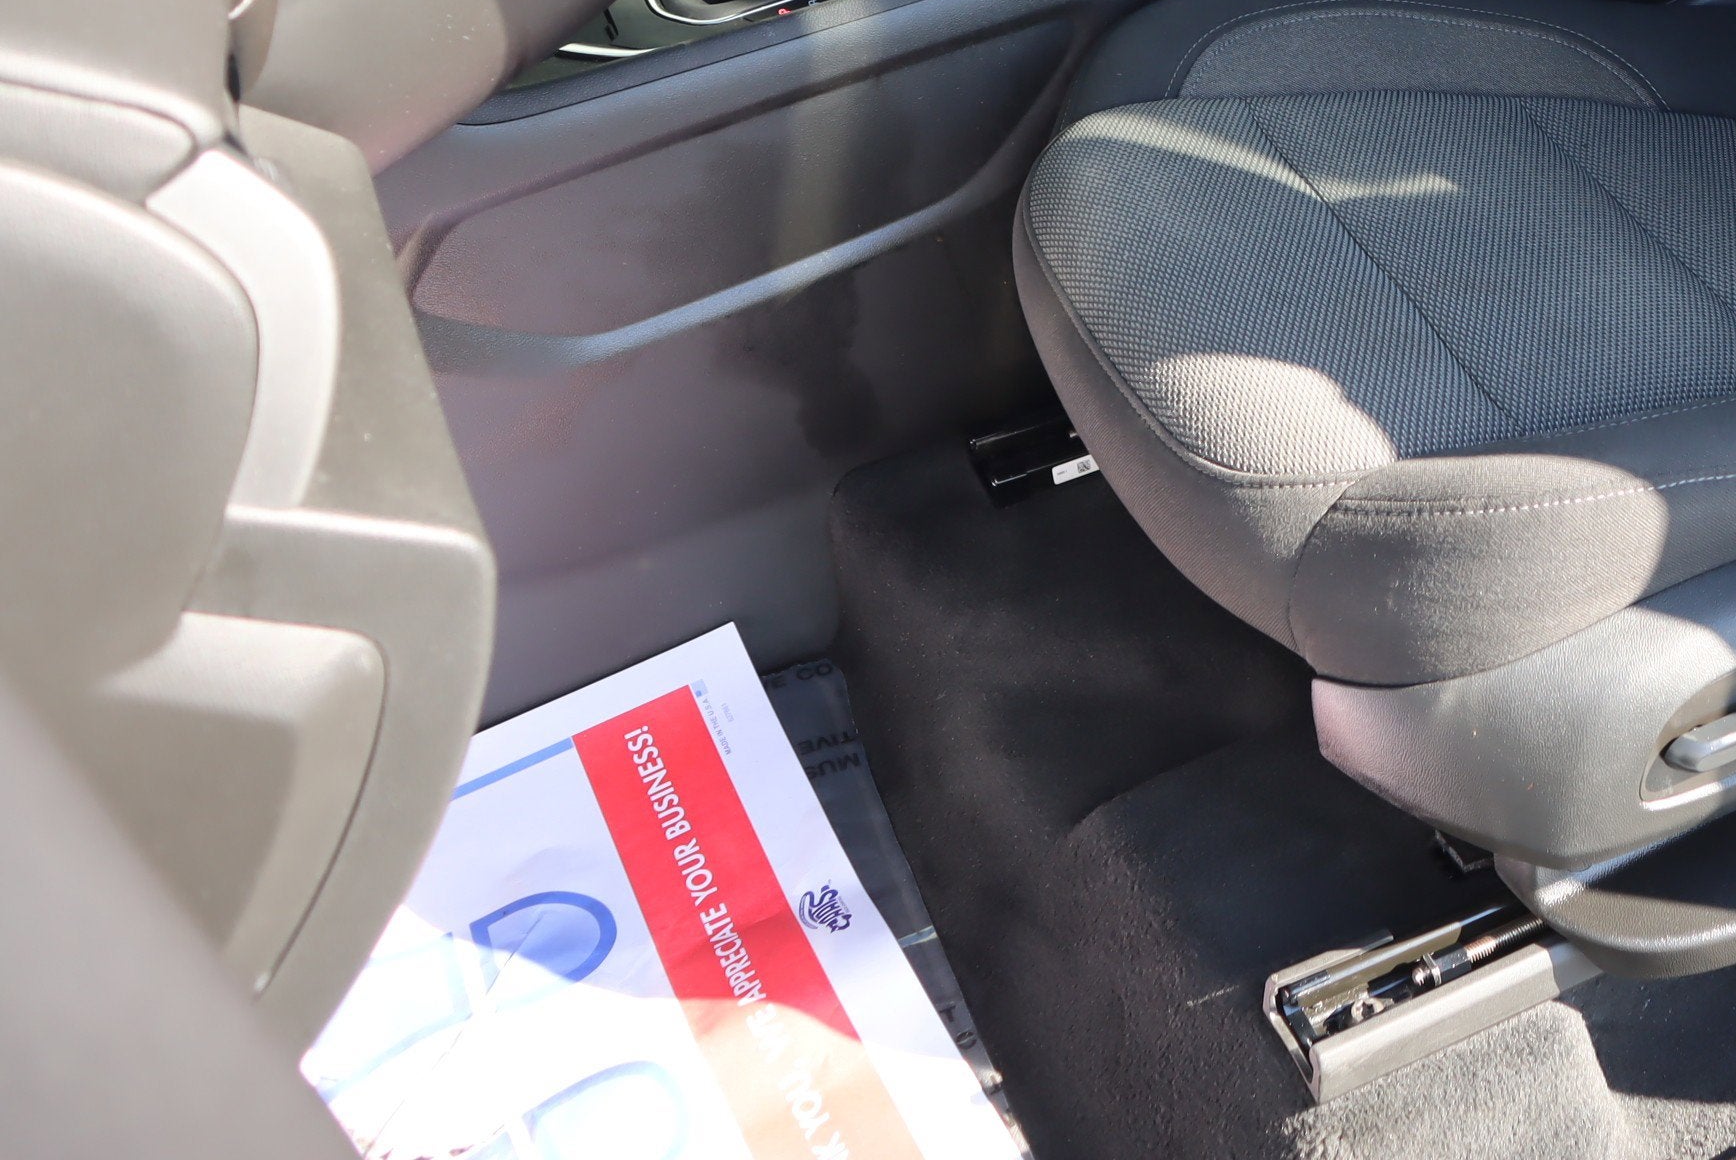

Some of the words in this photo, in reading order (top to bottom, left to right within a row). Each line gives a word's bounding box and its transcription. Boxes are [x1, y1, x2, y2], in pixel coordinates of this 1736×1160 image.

[710, 715, 720, 730] THE
[719, 736, 732, 755] MADE
[624, 724, 693, 841] BUSINESS!
[673, 837, 718, 906] YOUR
[700, 902, 767, 1007] APPRECIATE
